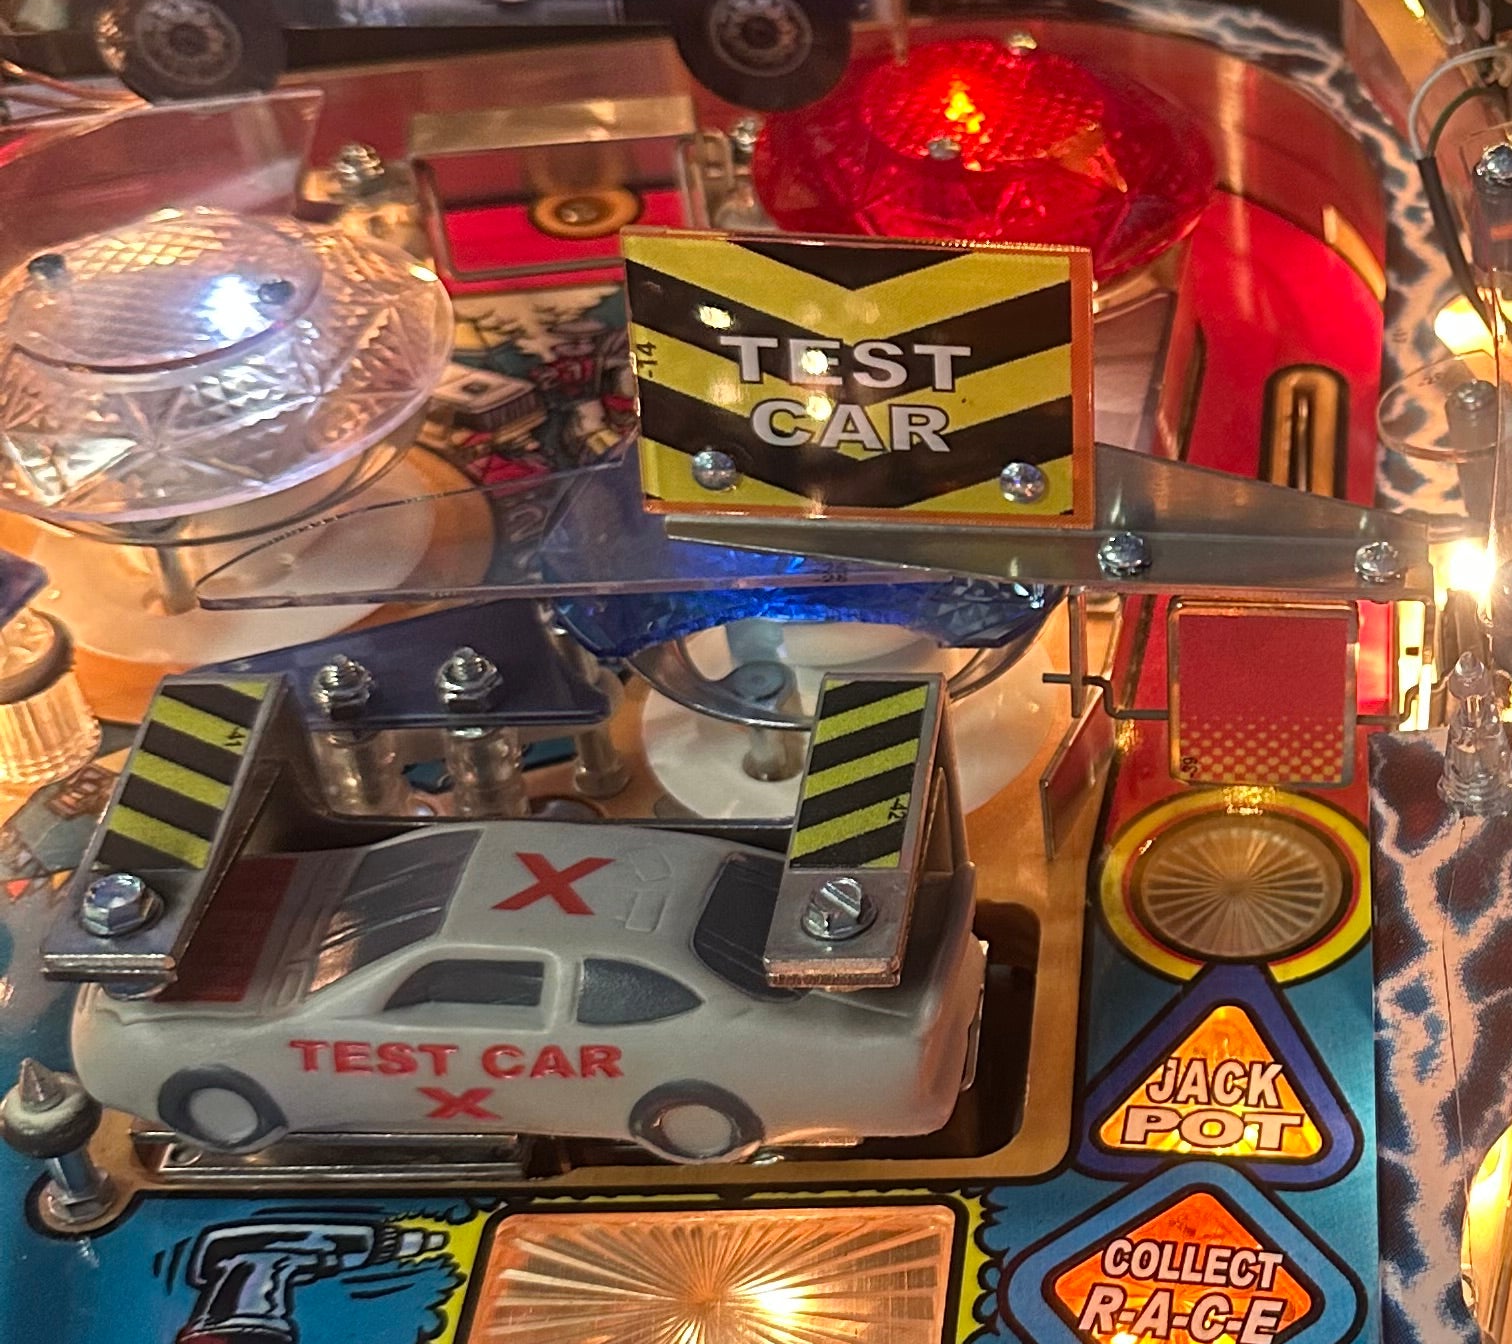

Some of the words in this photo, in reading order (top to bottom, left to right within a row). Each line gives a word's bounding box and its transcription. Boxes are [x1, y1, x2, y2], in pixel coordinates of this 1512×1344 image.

[718, 333, 972, 393] TEST
[749, 396, 951, 454] CAR
[289, 1039, 458, 1076] TEST
[482, 1042, 625, 1080] CAR
[1146, 1057, 1285, 1109] JACK
[1119, 1106, 1305, 1153] POT
[1101, 1238, 1286, 1292] COLLECT
